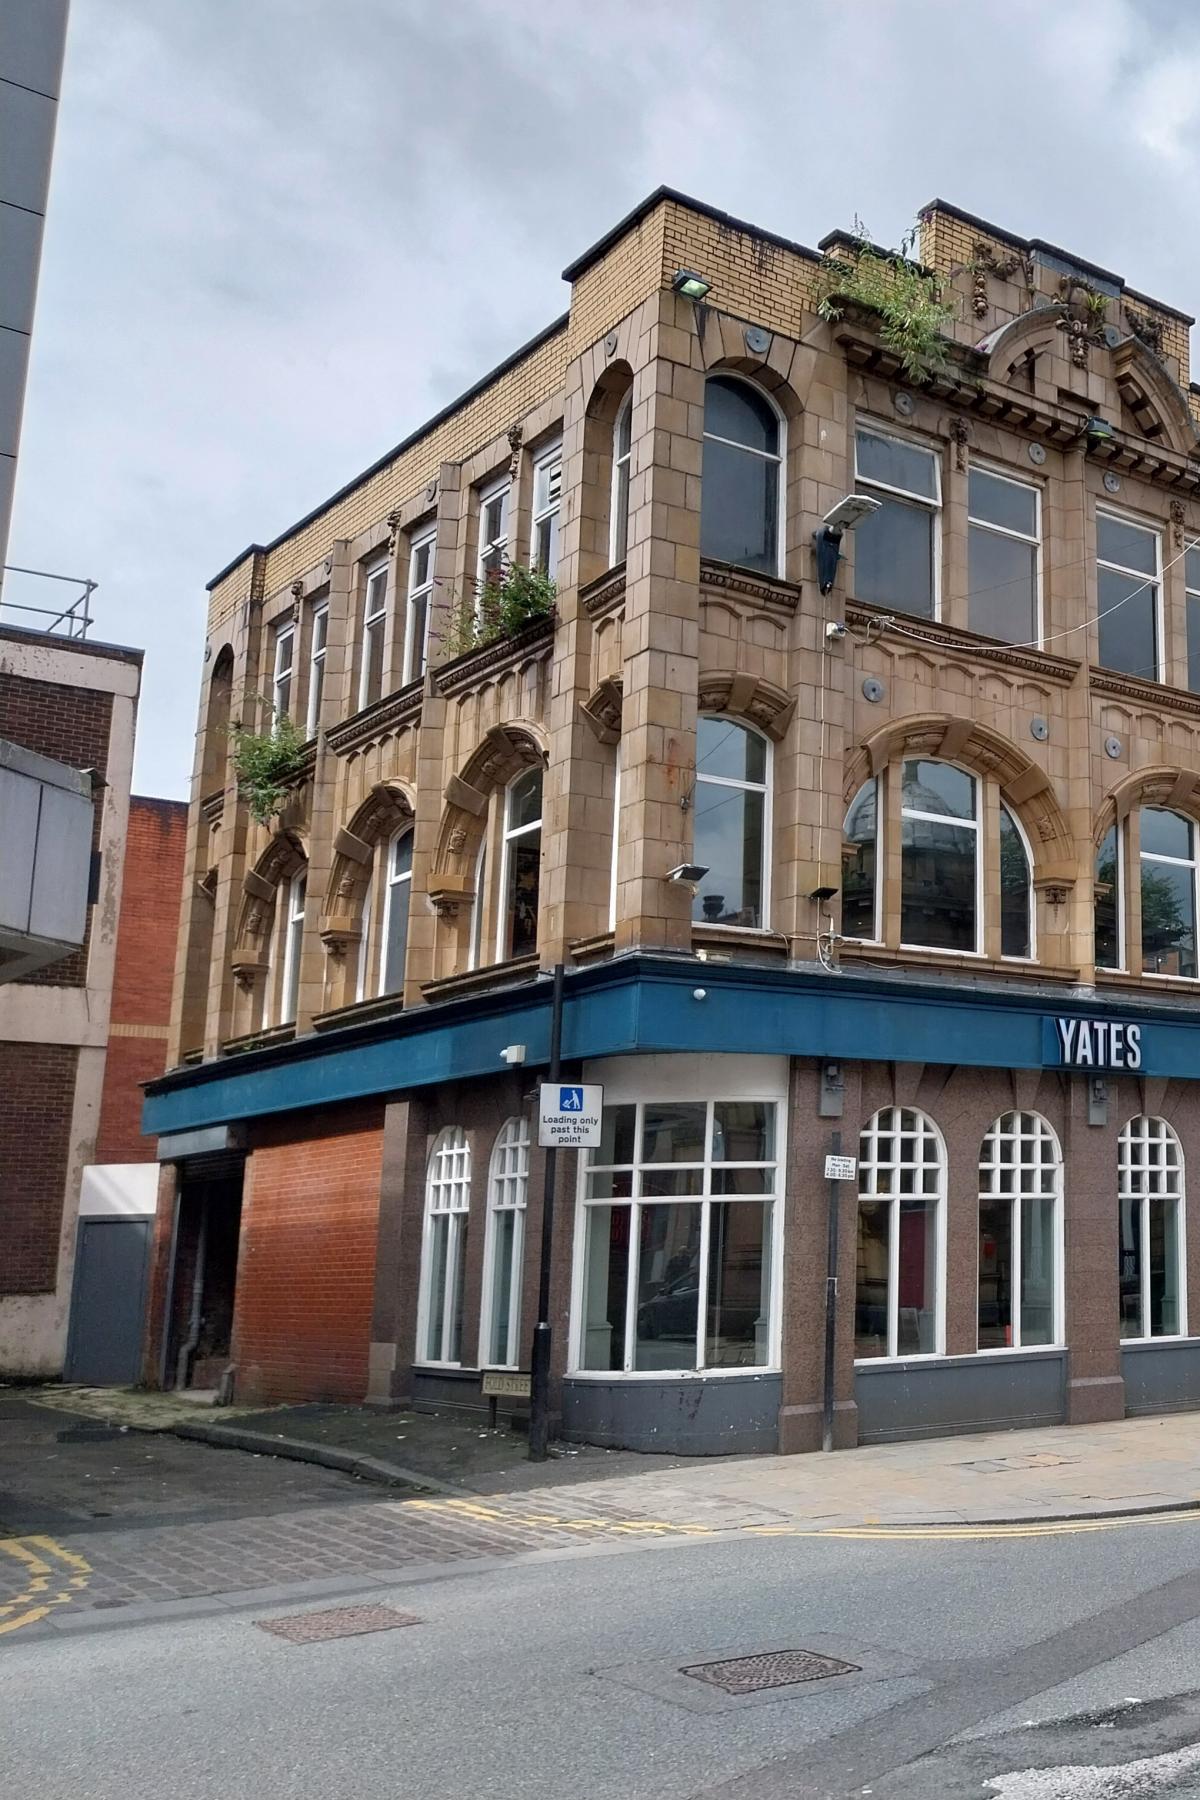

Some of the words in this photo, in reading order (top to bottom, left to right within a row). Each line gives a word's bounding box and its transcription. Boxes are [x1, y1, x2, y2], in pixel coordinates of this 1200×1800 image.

[1059, 1018, 1141, 1068] YATES
[543, 1116, 577, 1125] Loading
[580, 1117, 598, 1126] only
[551, 1126, 570, 1134] past
[559, 1135, 581, 1144] point
